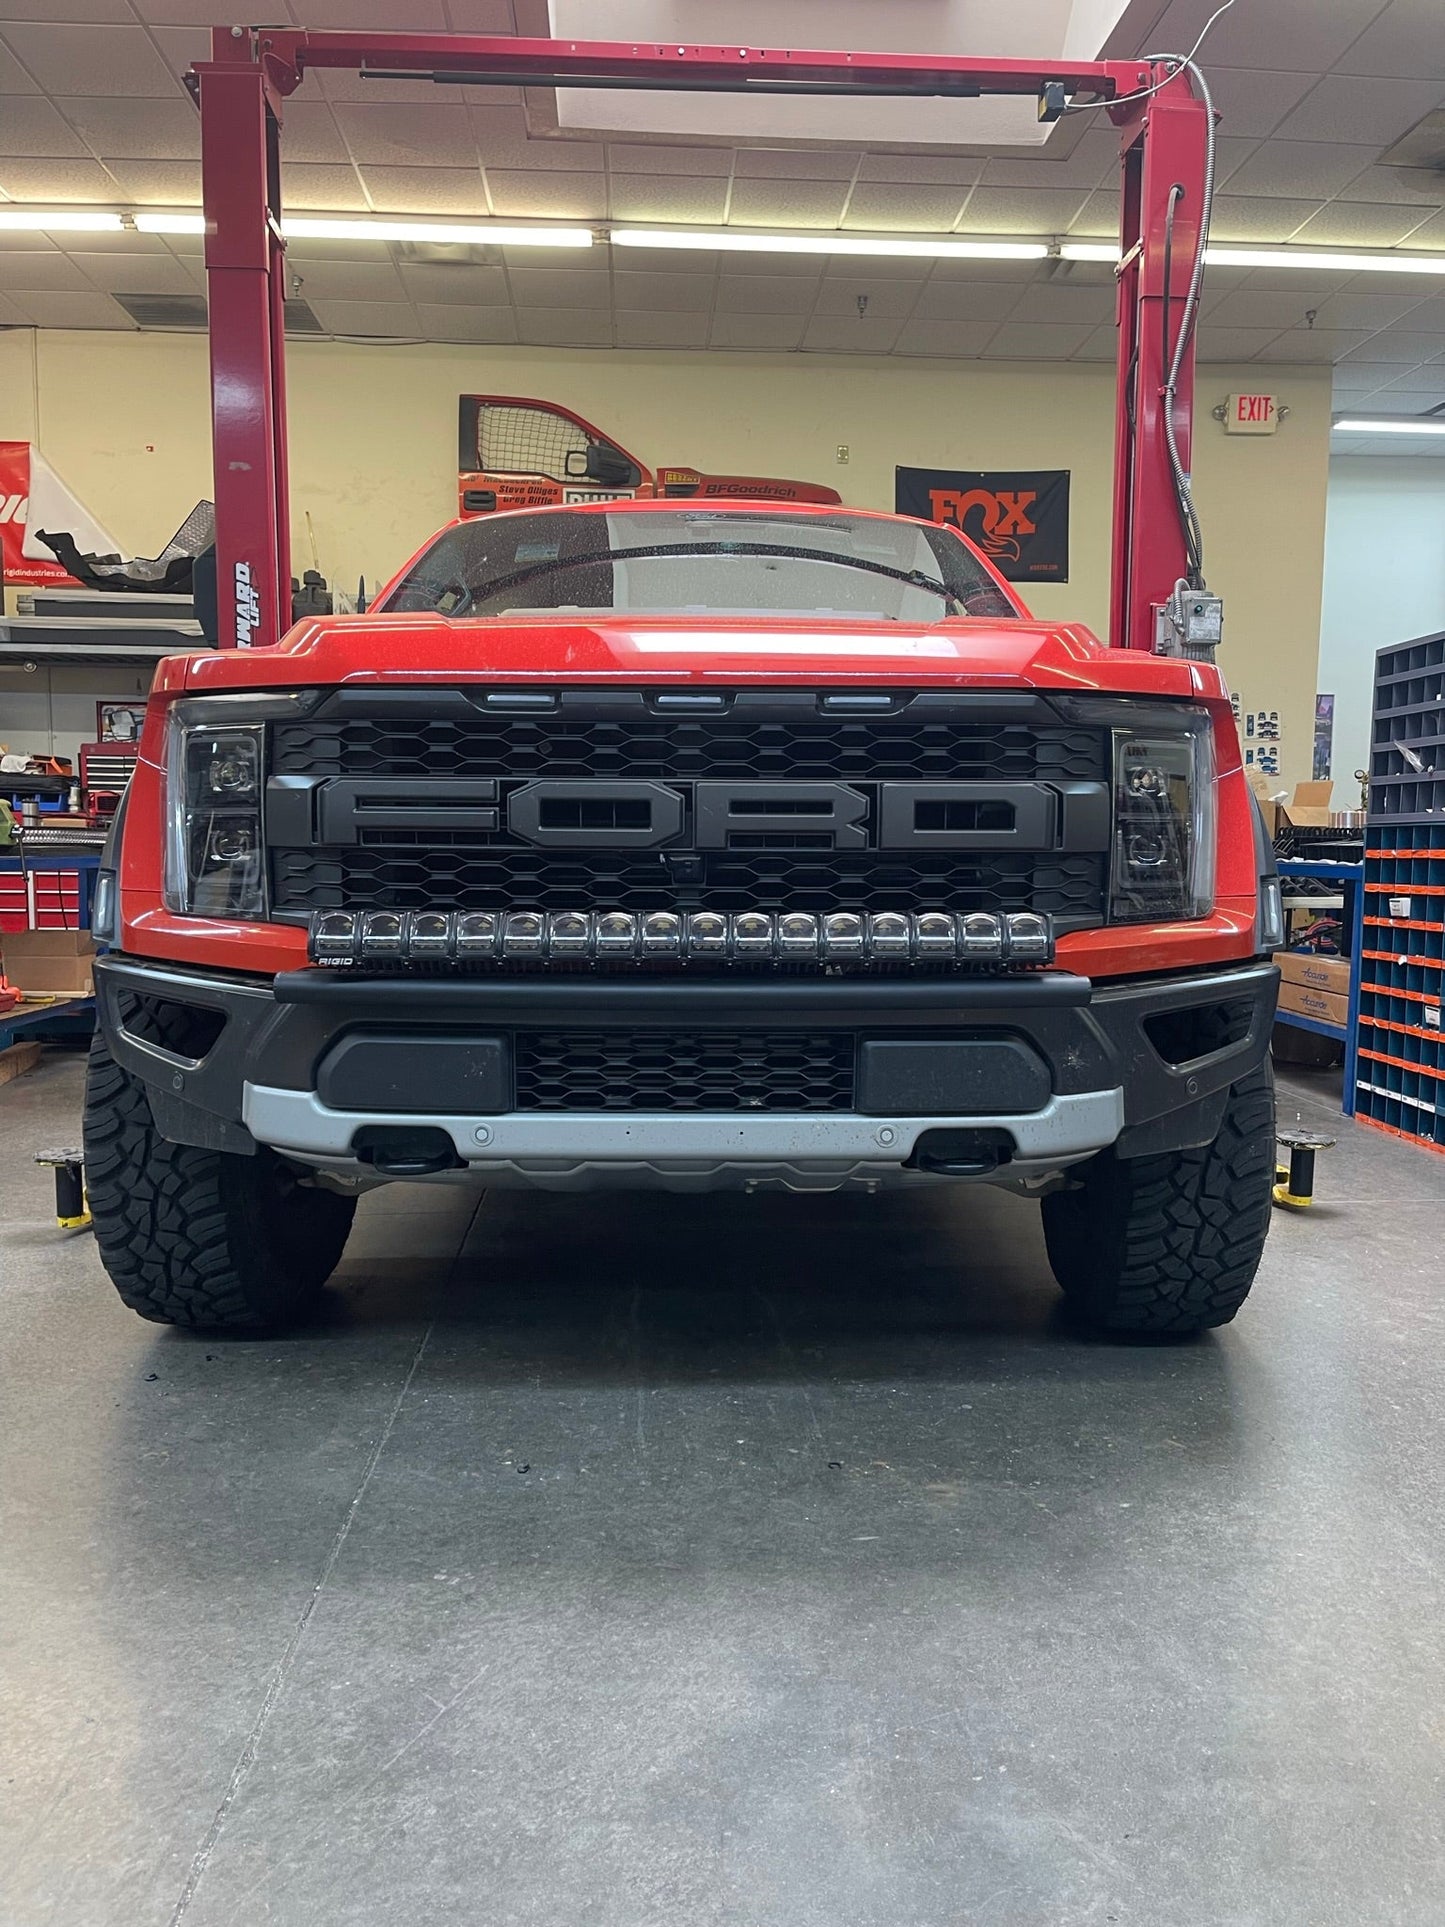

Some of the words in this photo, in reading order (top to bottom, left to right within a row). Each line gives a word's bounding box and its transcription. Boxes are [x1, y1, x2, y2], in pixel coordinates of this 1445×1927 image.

[1238, 396, 1271, 421] EXIT
[499, 485, 526, 494] Steve
[705, 484, 796, 498] BFGoodrich
[929, 489, 1036, 535] FOX
[249, 587, 260, 628] LIFT
[322, 777, 1056, 851] FORD
[318, 957, 354, 966] RIGID
